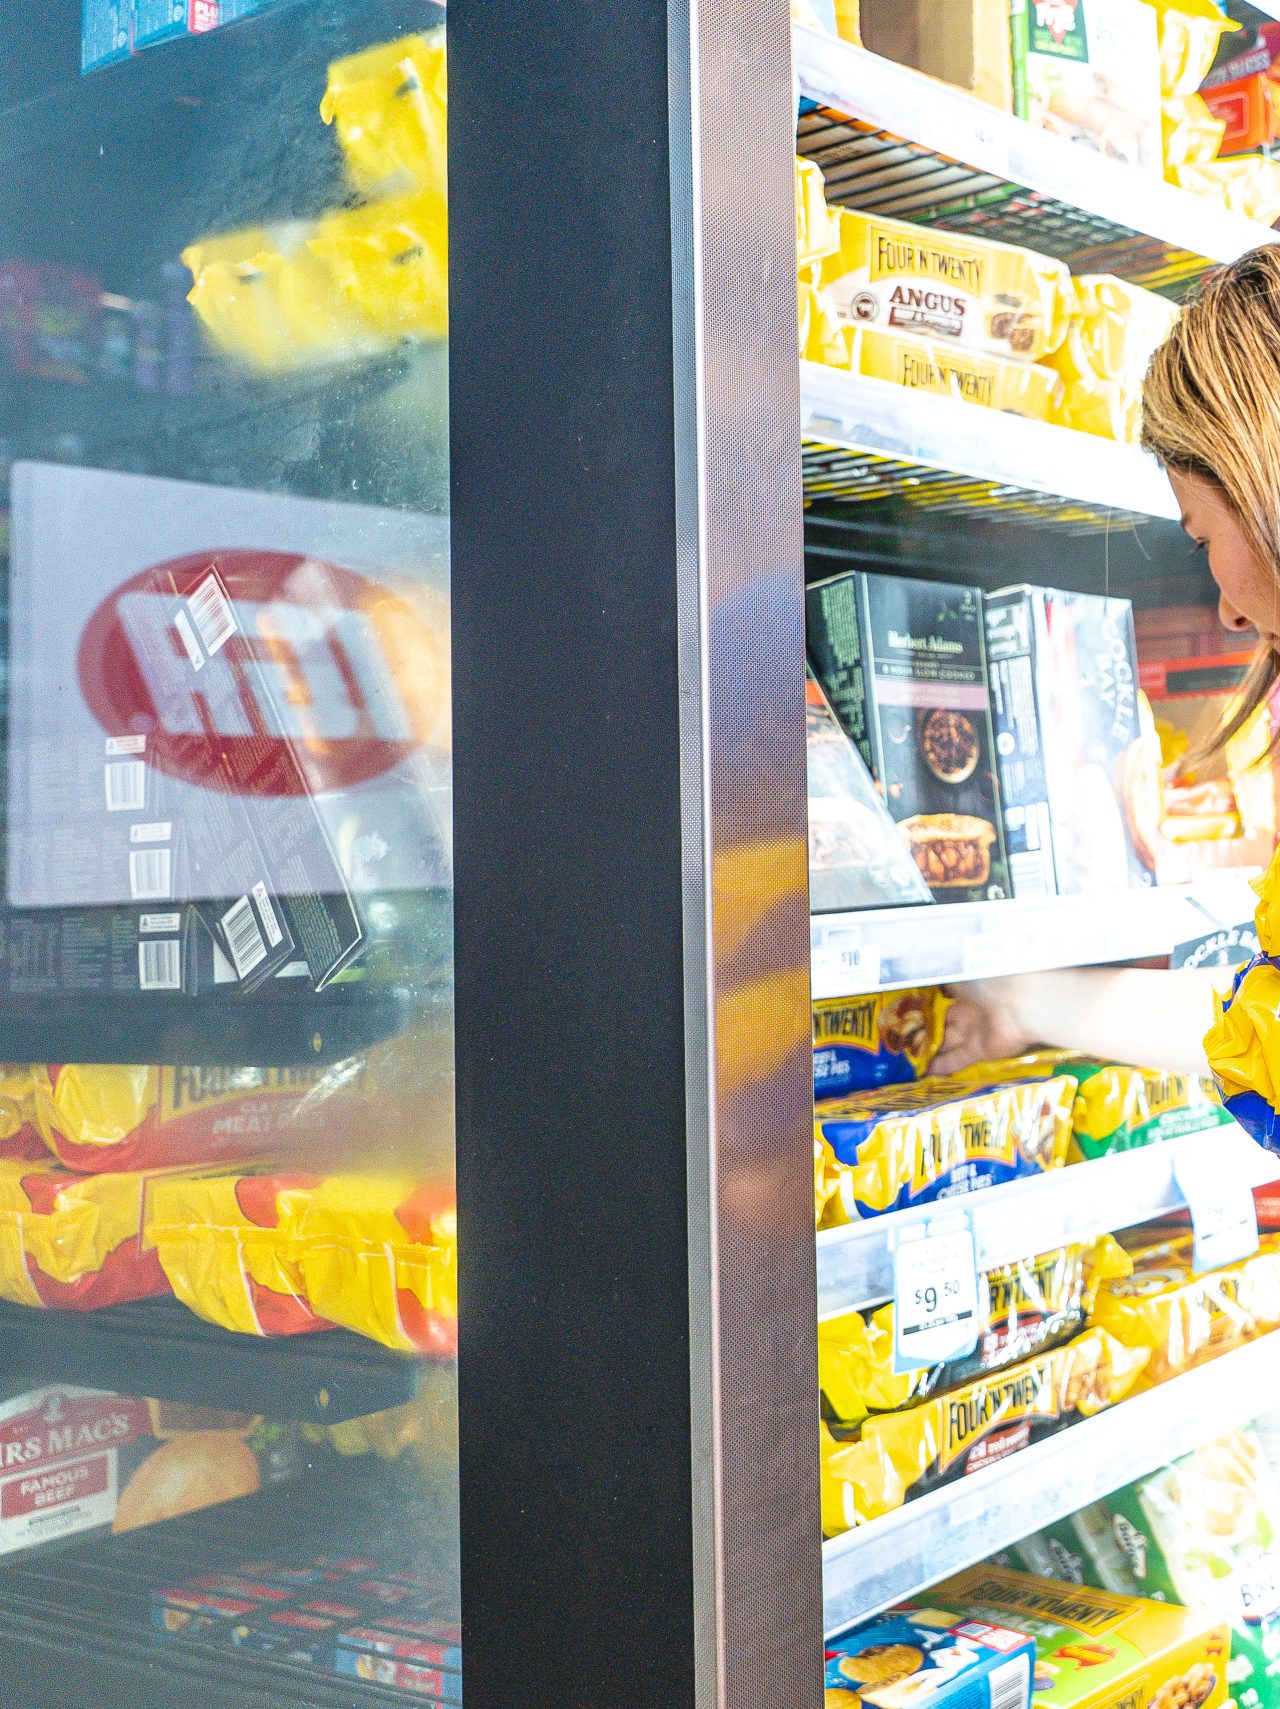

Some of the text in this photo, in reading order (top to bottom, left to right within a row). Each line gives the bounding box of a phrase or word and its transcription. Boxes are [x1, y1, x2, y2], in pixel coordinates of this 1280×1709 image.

[931, 252, 983, 295] TWENTY
[889, 285, 966, 316] ANGUS
[914, 1279, 960, 1313] $9.50
[20, 1467, 90, 1496] FAMOUS
[35, 1485, 78, 1505] BEEF
